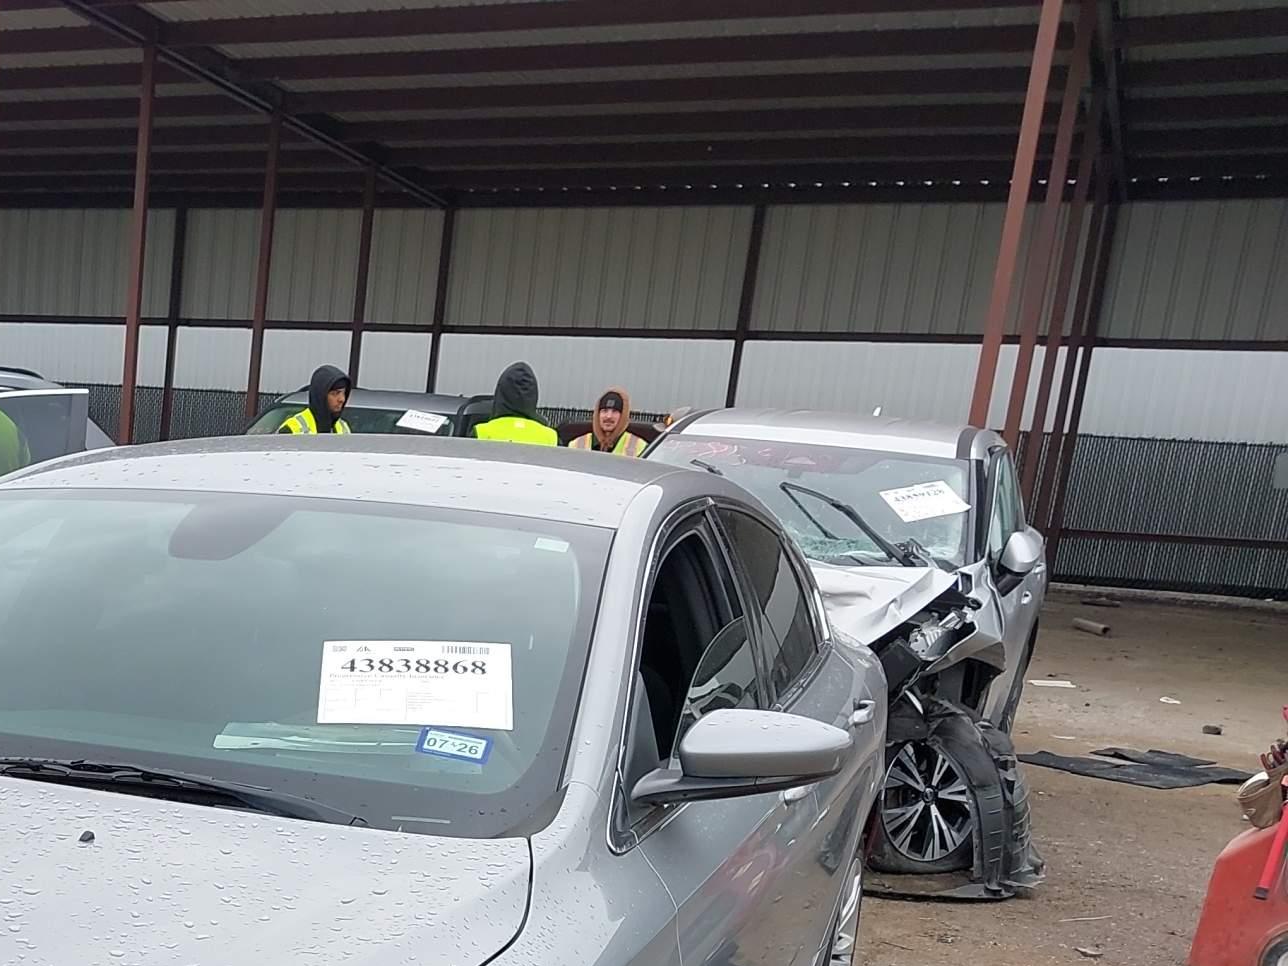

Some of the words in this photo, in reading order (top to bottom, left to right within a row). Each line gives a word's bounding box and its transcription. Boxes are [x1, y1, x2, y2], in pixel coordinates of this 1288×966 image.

[340, 657, 488, 676] 43838868
[426, 737, 449, 749] 07
[456, 743, 479, 755] 26
